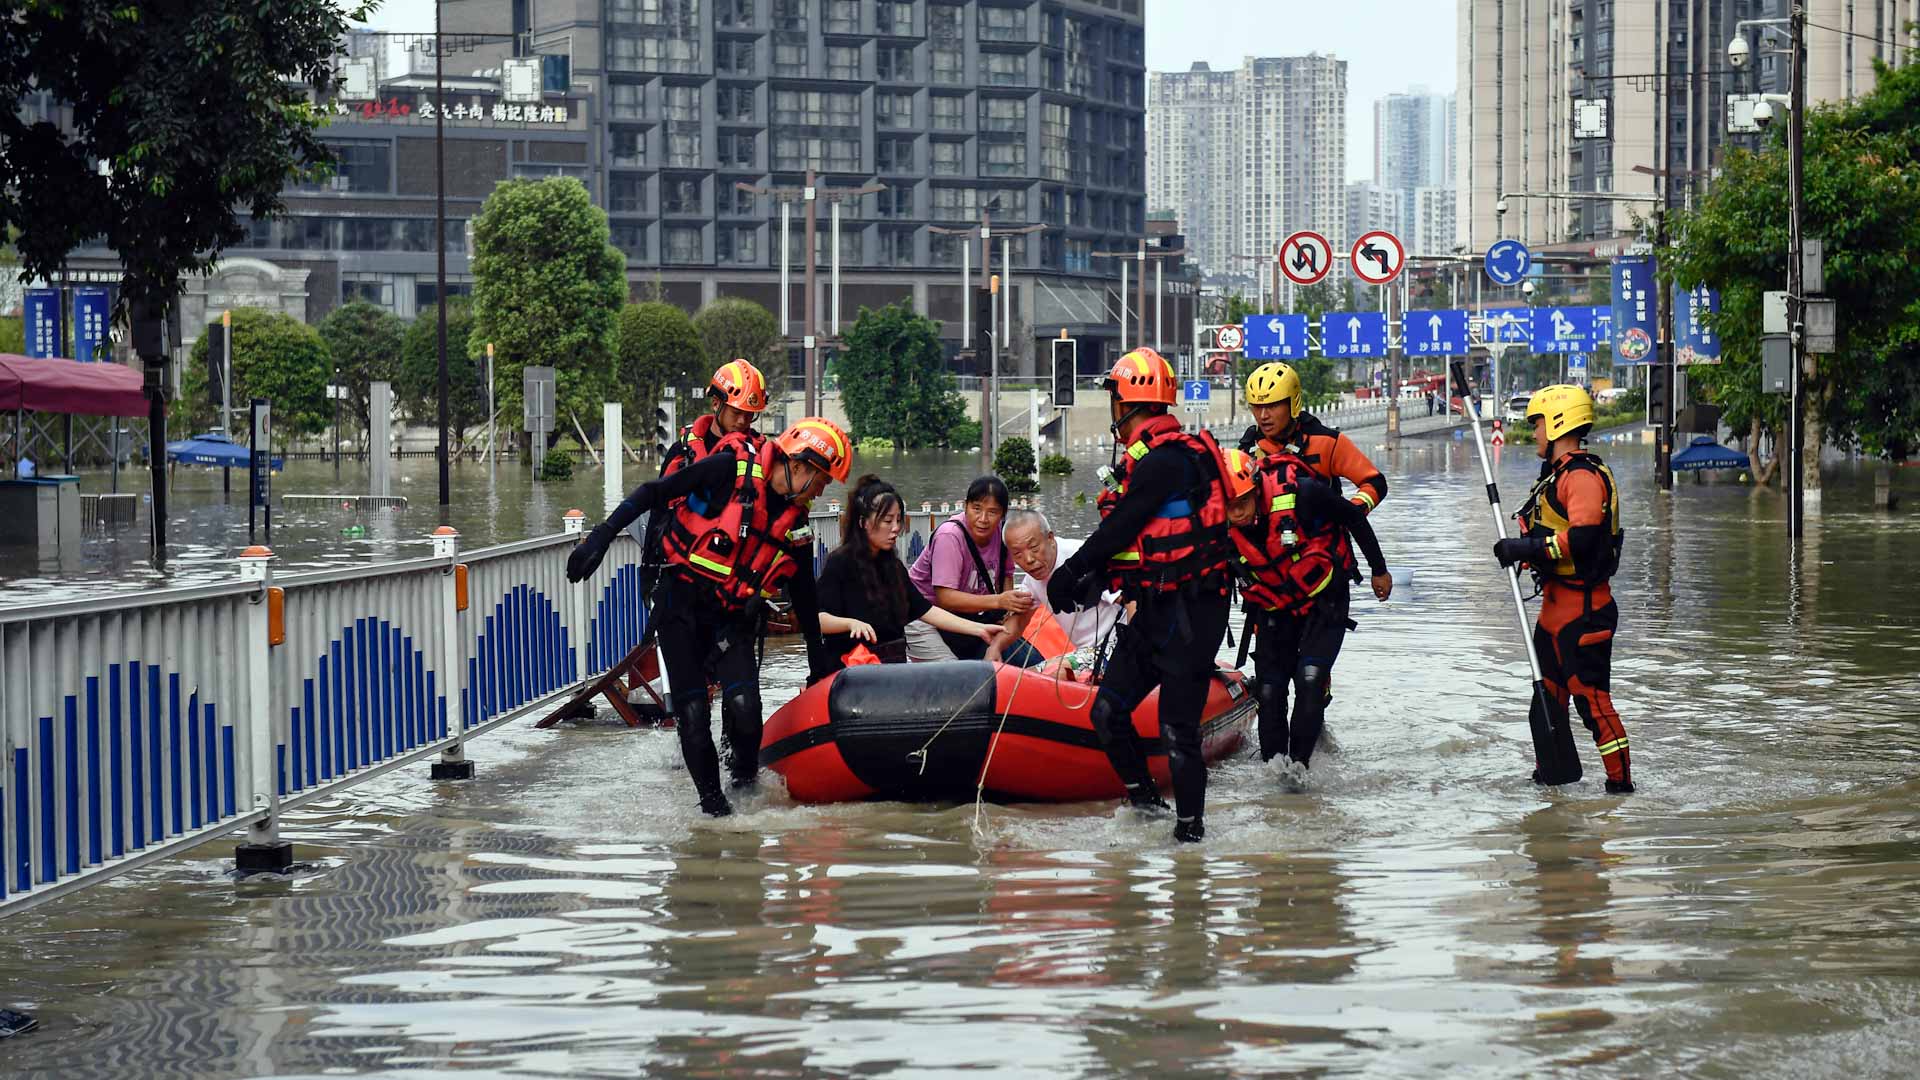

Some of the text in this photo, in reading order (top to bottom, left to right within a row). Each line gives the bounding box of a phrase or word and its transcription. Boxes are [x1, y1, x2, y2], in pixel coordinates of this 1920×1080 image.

[418, 101, 484, 120] 受气牛肉
[491, 104, 554, 122] 楊記隆府
[83, 304, 92, 340] 绿水青山
[1259, 346, 1292, 356] 下河路
[1338, 344, 1371, 354] 沙滨路
[1419, 341, 1452, 352] 沙滨路
[1546, 341, 1580, 352] 沙滨路
[1193, 387, 1202, 400] P
